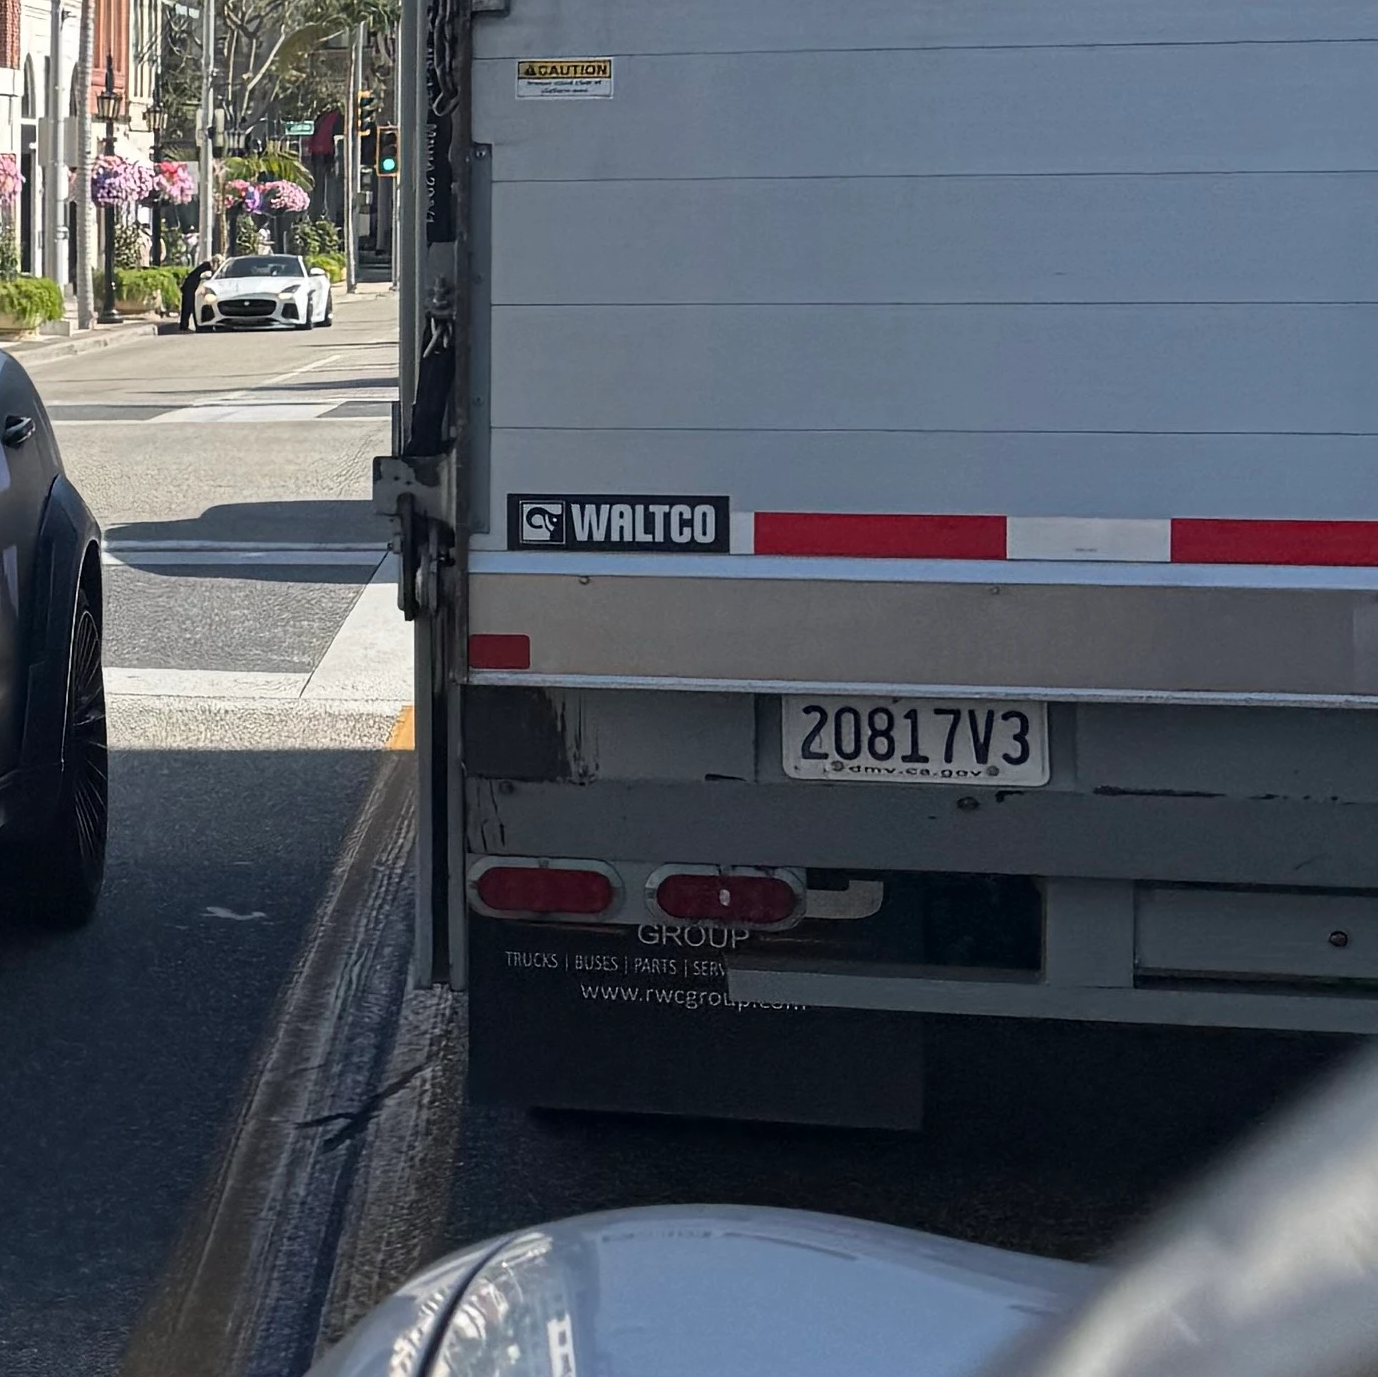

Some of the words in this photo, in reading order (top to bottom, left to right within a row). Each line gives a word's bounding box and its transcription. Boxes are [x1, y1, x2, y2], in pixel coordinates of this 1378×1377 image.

[538, 64, 608, 76] CAUTION
[570, 503, 716, 544] WALTCO
[801, 705, 1030, 765] 20817V3
[848, 764, 982, 779] dmv.ca.gov
[638, 924, 749, 949] GROUP
[506, 950, 558, 968] TRUCKS
[575, 954, 618, 972] BUSES
[635, 958, 676, 975] PARTS
[581, 984, 806, 1012] www.rwcgroup.
